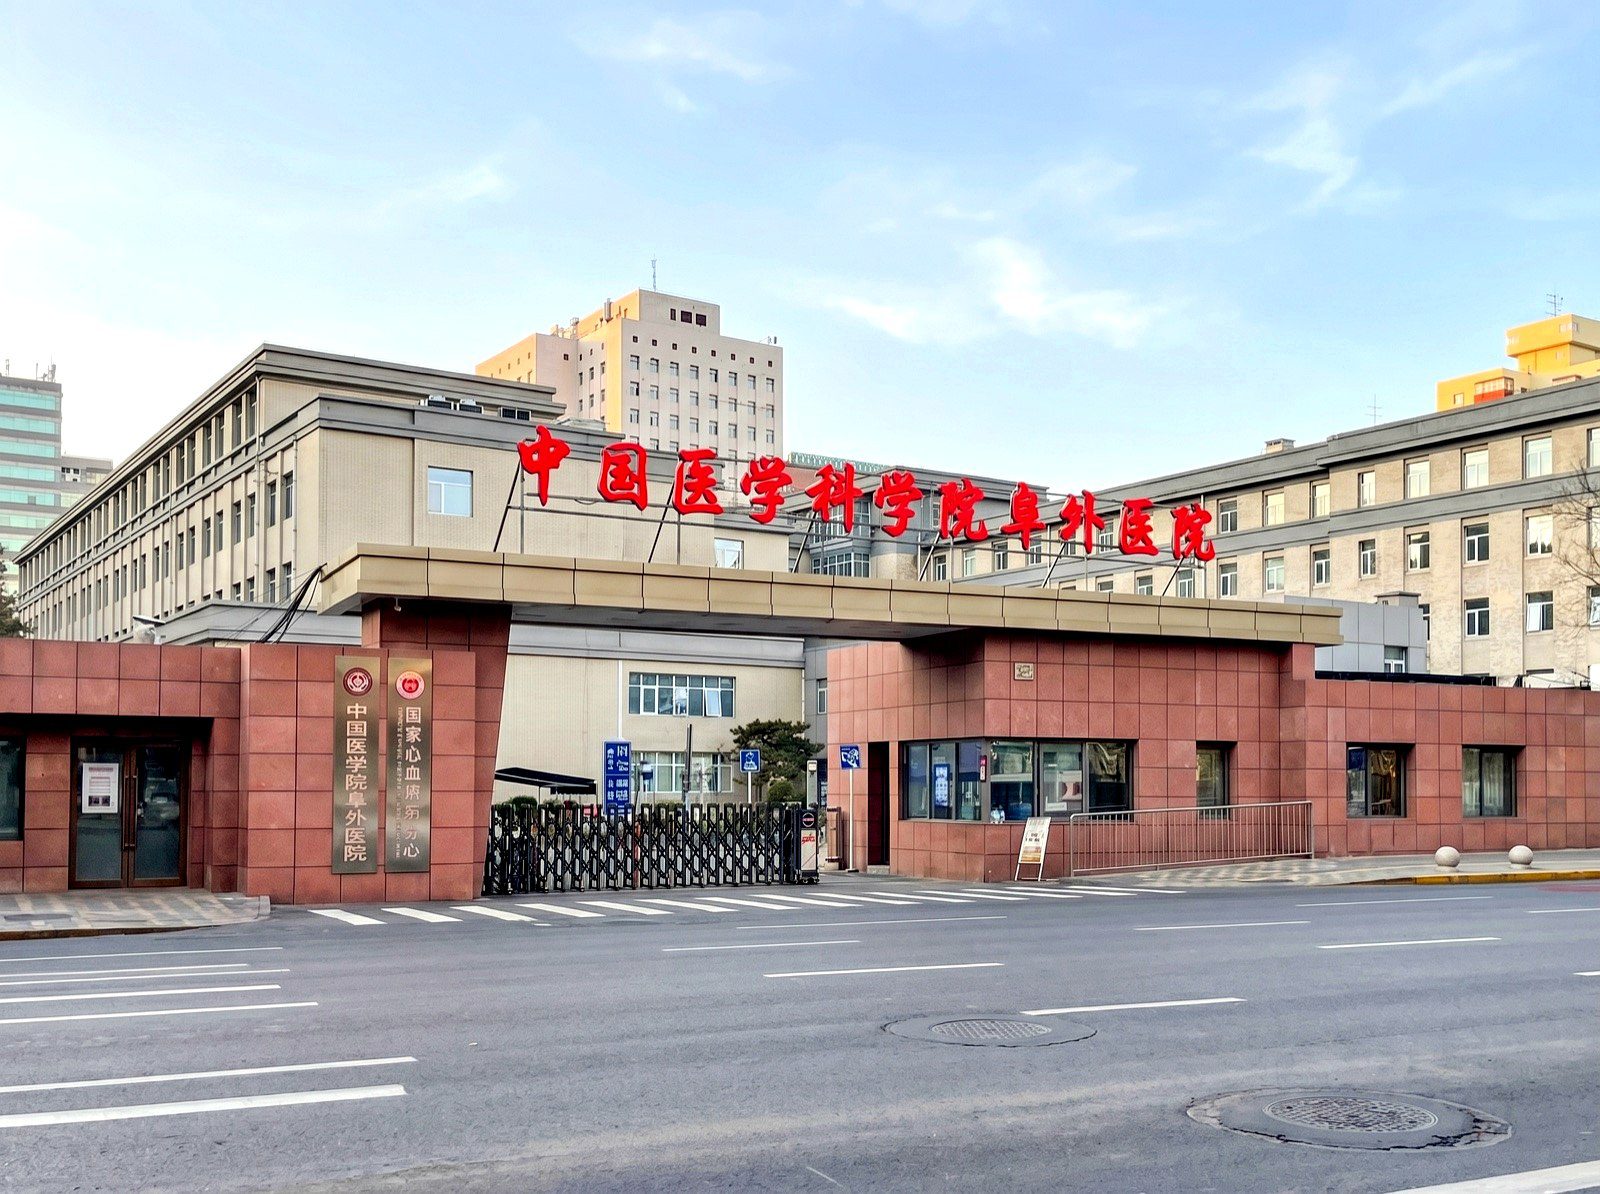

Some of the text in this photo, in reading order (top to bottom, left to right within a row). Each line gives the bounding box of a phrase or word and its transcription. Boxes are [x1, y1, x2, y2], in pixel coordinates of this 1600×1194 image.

[517, 425, 1216, 561] 中国医学科学院阜外医院
[343, 702, 368, 862] 中国医学院阜外医院
